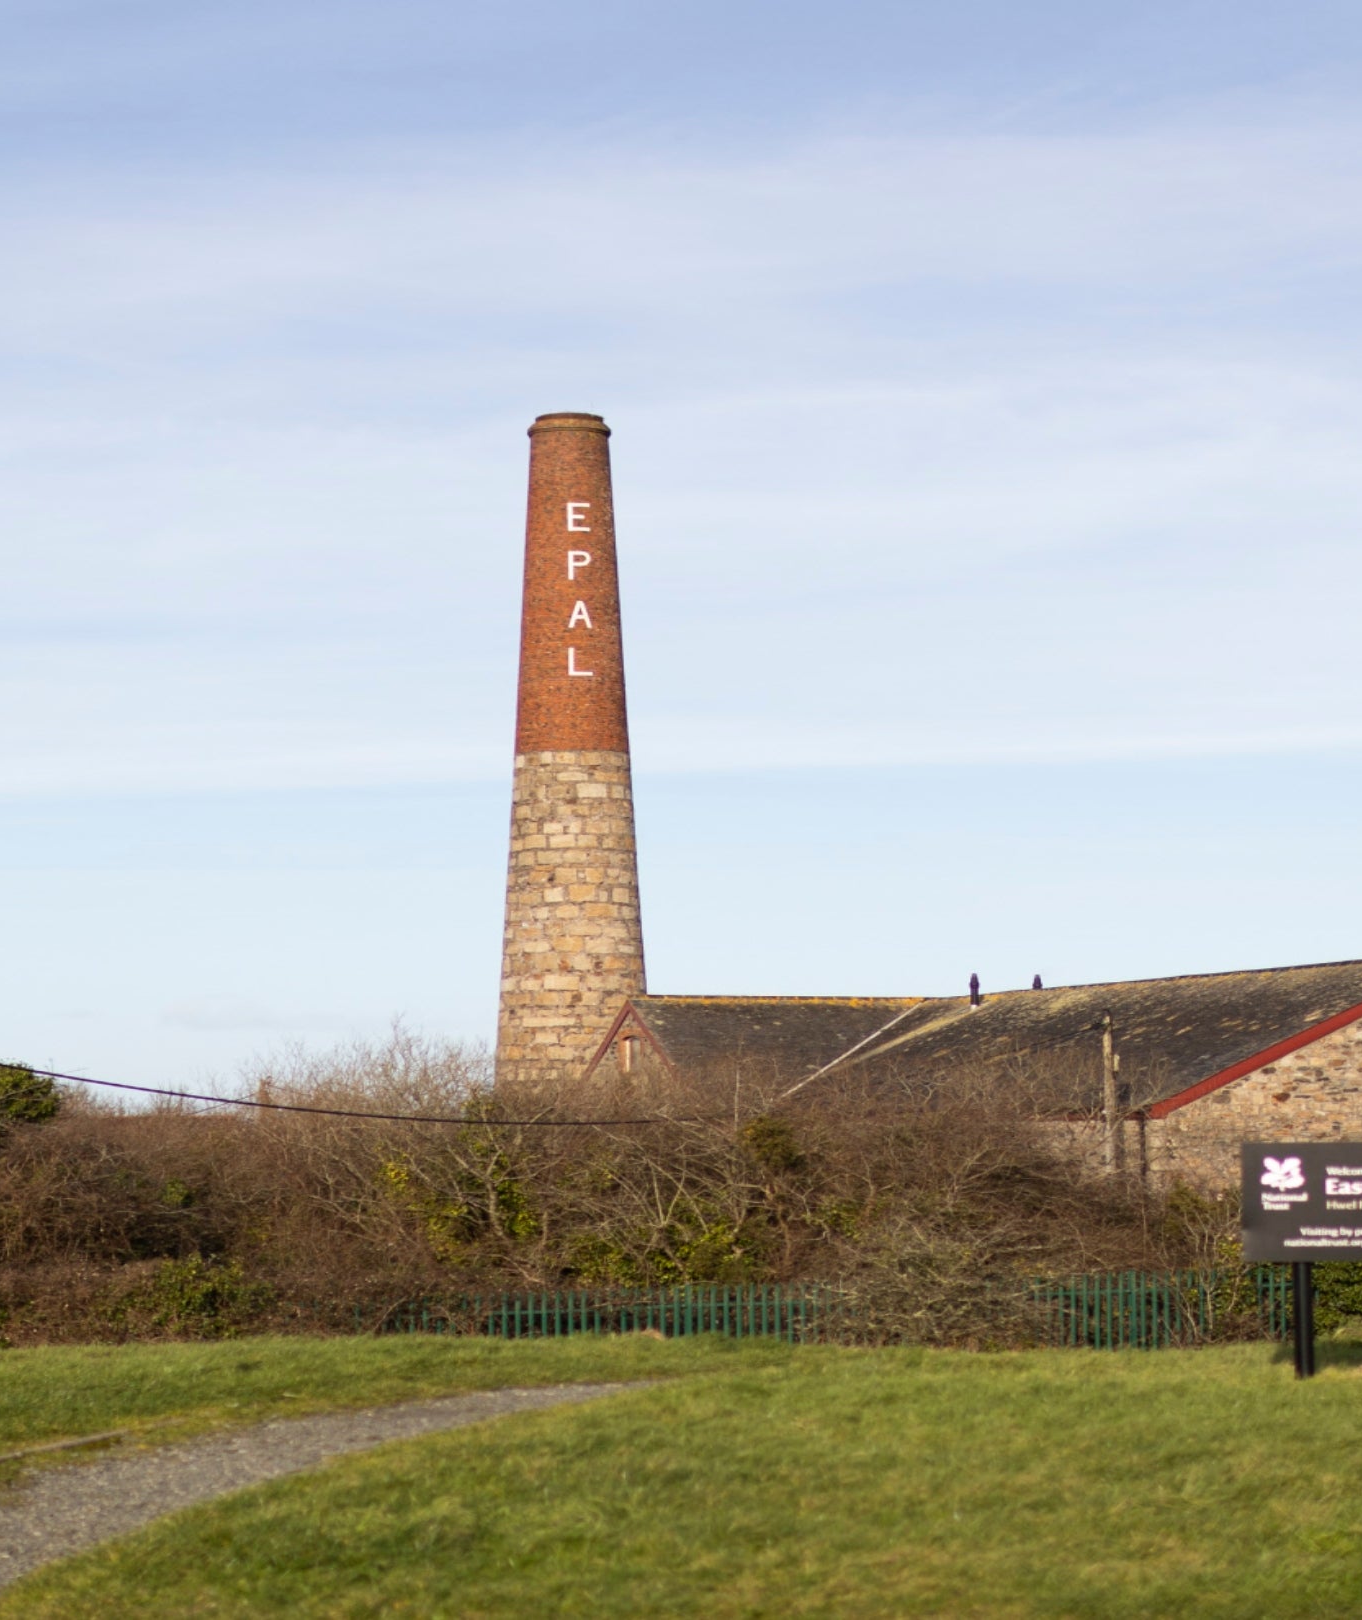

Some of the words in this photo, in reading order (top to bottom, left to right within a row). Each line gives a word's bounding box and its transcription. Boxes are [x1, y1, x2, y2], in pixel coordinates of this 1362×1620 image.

[1261, 1191, 1309, 1202] National
[1261, 1202, 1290, 1211] Trust
[1326, 1199, 1357, 1211] Hwel
[1299, 1226, 1339, 1238] Visiting
[1339, 1226, 1353, 1238] by
